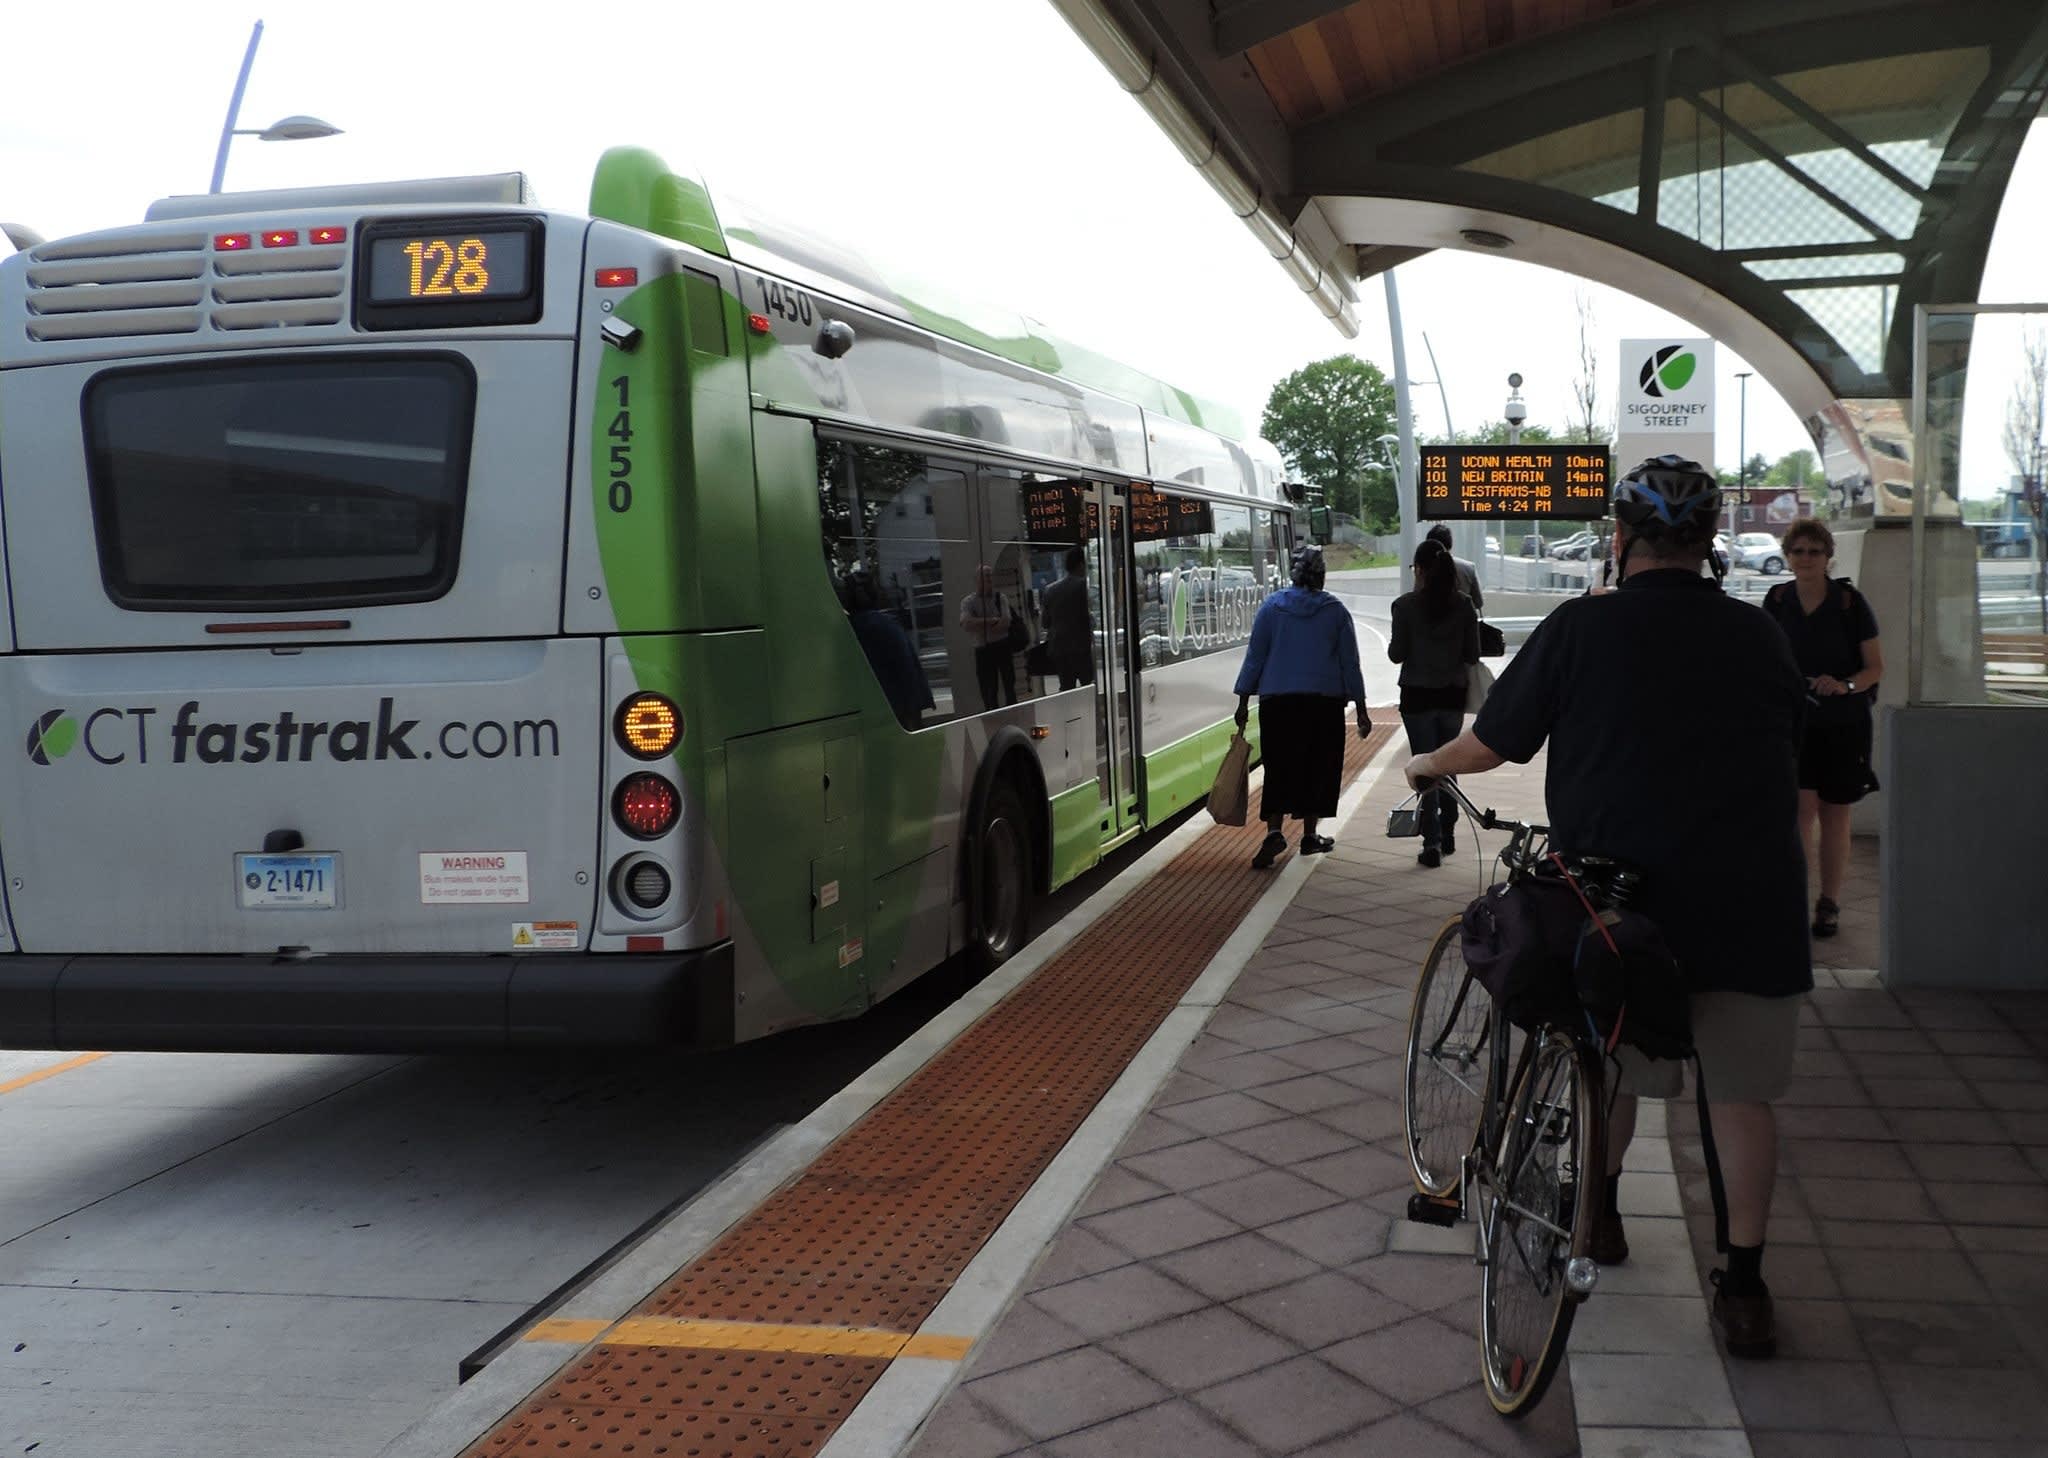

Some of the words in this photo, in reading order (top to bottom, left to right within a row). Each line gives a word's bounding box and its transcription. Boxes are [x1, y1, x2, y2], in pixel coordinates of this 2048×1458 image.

[403, 239, 489, 296] 128
[756, 276, 812, 327] 1450
[1627, 403, 1707, 415] SIGOURNEY
[1643, 416, 1689, 427] STREET
[607, 375, 634, 514] 1450
[1425, 456, 1447, 468] 121
[1461, 456, 1500, 468] UCONN
[1505, 456, 1552, 468] HEALTH
[1565, 456, 1604, 468] 10min
[1425, 471, 1447, 483] 101
[1461, 471, 1485, 483] NEW
[1491, 471, 1544, 483] BRITAIN
[1565, 471, 1604, 483] 14min
[1425, 486, 1448, 498] 128
[1461, 486, 1552, 498] WESTFARMS-NB
[1565, 486, 1604, 498] 14min
[1461, 500, 1492, 512] Time
[1498, 500, 1528, 512] 4:24
[1535, 500, 1552, 512] PM
[84, 707, 157, 766] CT
[171, 697, 560, 764] fastrak.com
[441, 857, 505, 869] WARNING
